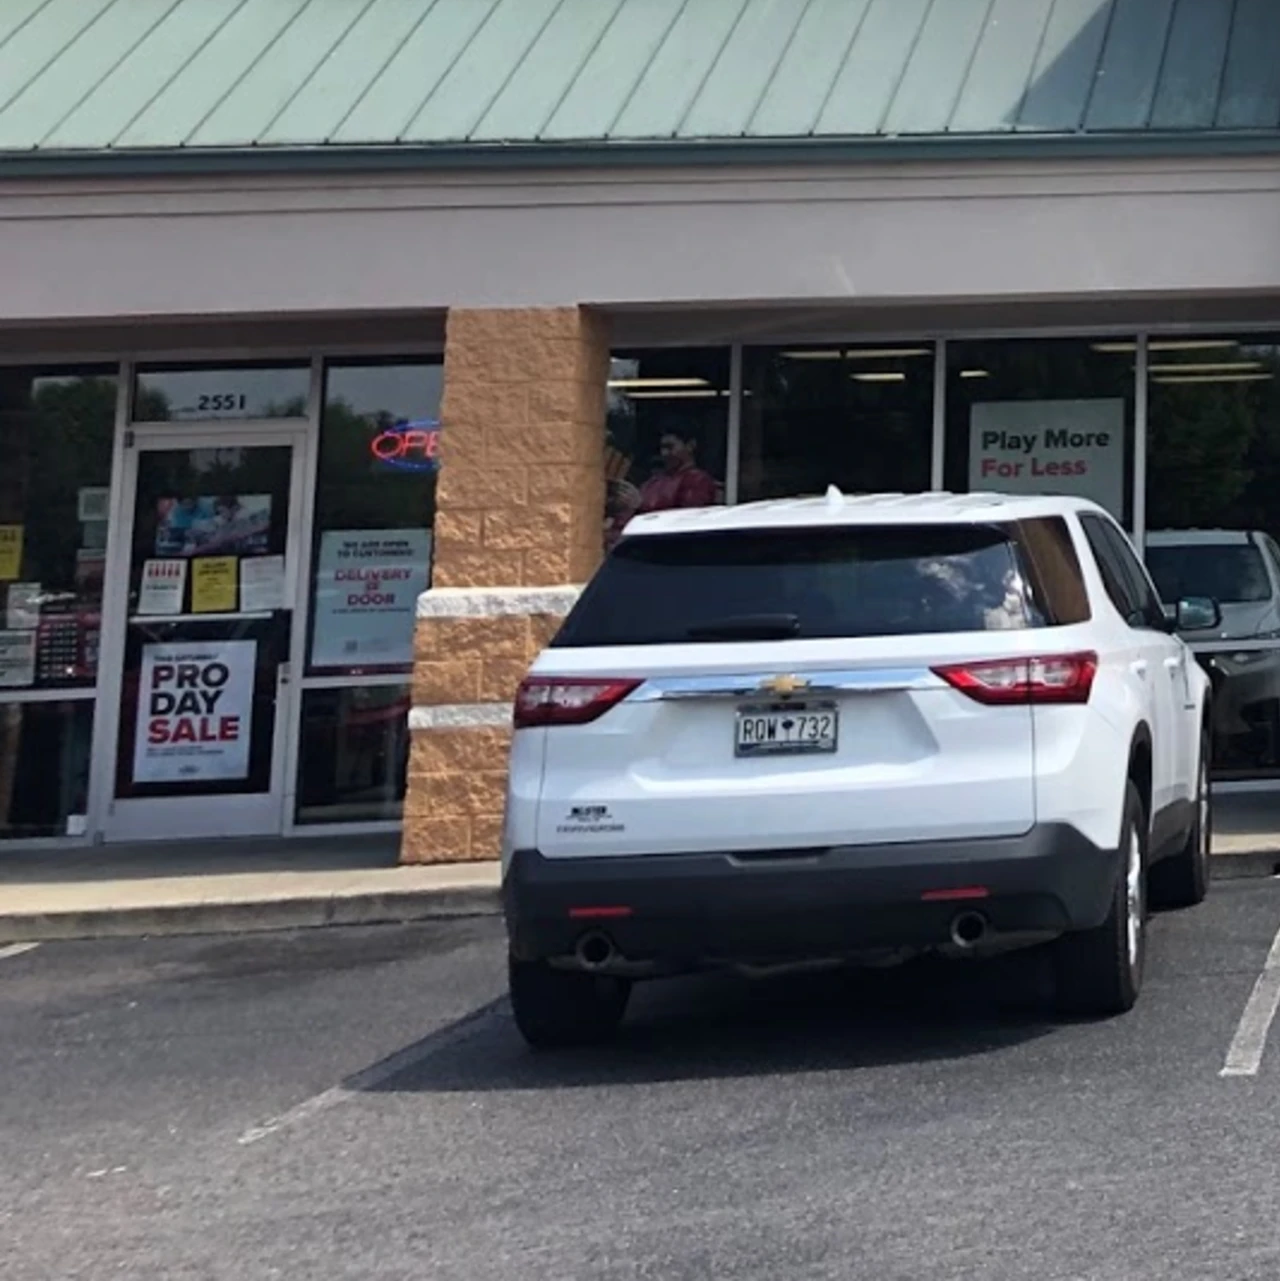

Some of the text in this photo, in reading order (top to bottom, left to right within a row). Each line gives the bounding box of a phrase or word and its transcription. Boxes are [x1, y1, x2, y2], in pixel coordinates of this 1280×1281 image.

[198, 394, 246, 411] 2551
[371, 431, 440, 459] OPE
[981, 428, 1110, 454] Play More
[980, 457, 1088, 477] For Less
[334, 568, 412, 581] DELIVERY
[347, 593, 395, 605] DOOR
[151, 662, 230, 689] PRO
[149, 689, 224, 716] DAY
[147, 716, 240, 744] SALE
[796, 716, 831, 739] 732
